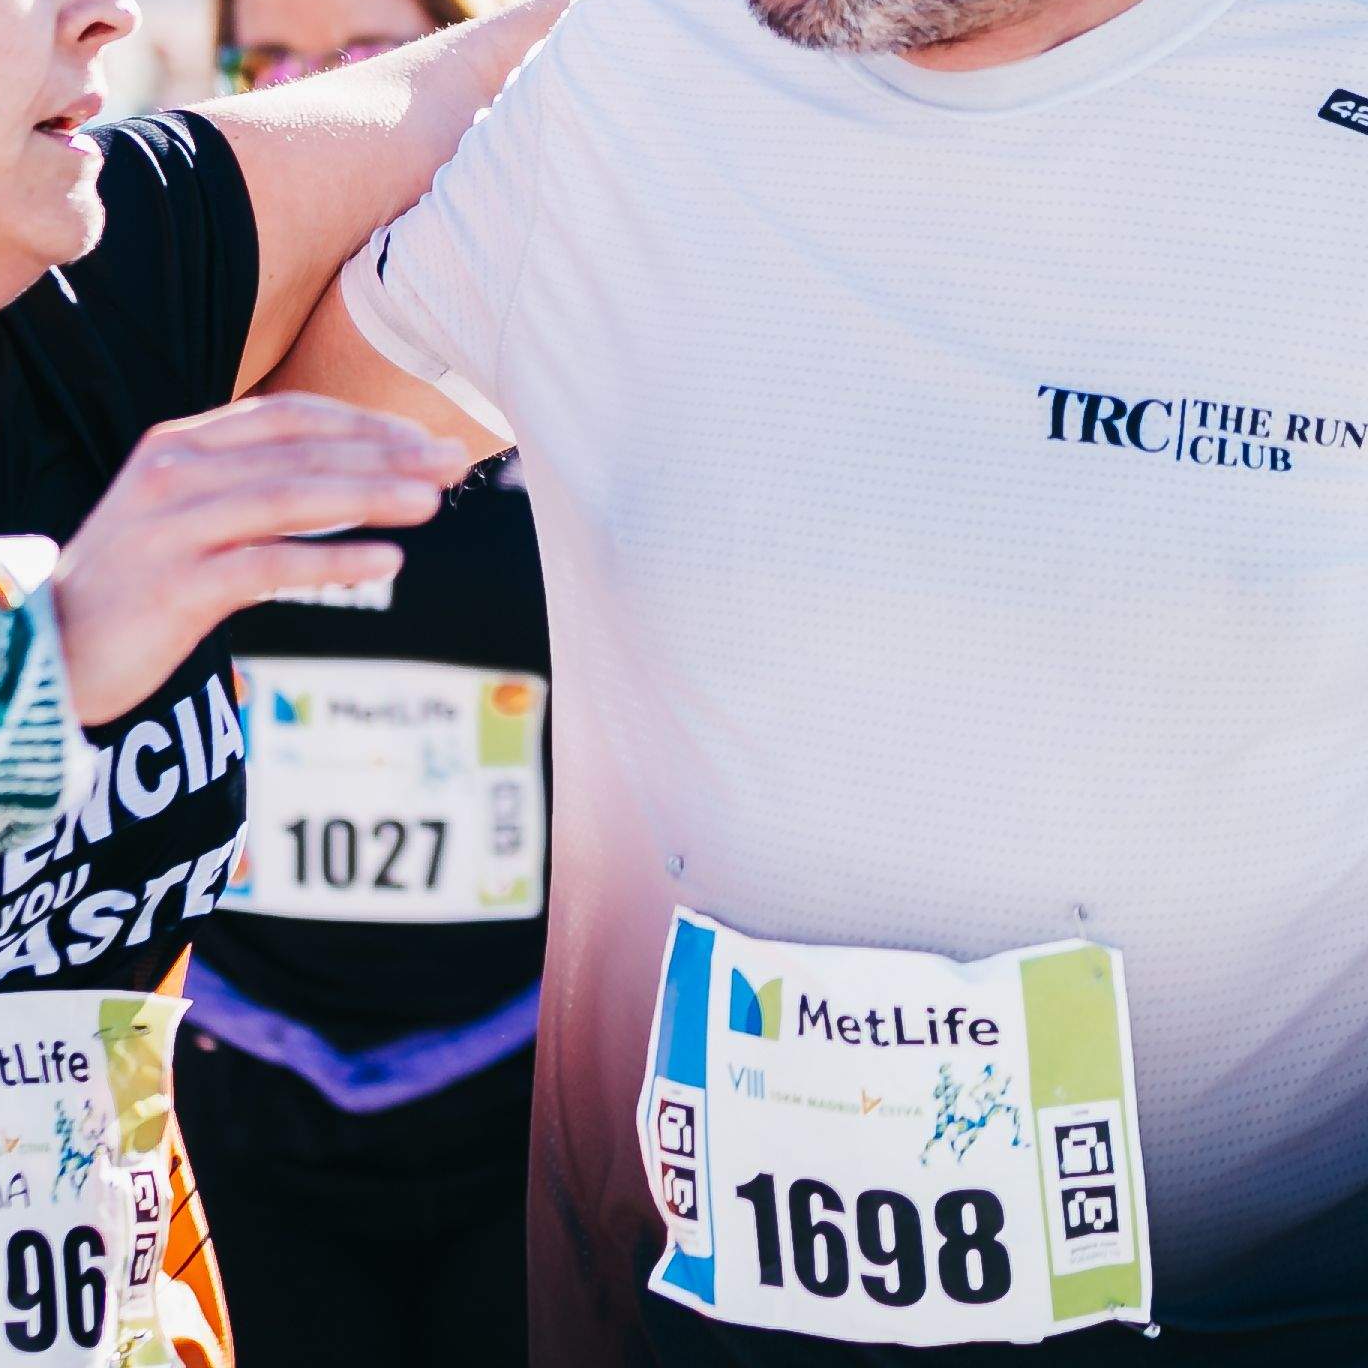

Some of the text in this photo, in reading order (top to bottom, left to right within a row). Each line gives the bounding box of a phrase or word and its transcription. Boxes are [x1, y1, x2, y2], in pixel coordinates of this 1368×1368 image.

[1038, 385, 1172, 454] TRC
[1193, 400, 1368, 450] THE RUN
[1189, 434, 1292, 473] CLUB
[287, 818, 449, 890] 1027
[798, 993, 1000, 1047] MetLife
[736, 1172, 1011, 1308] 1698
